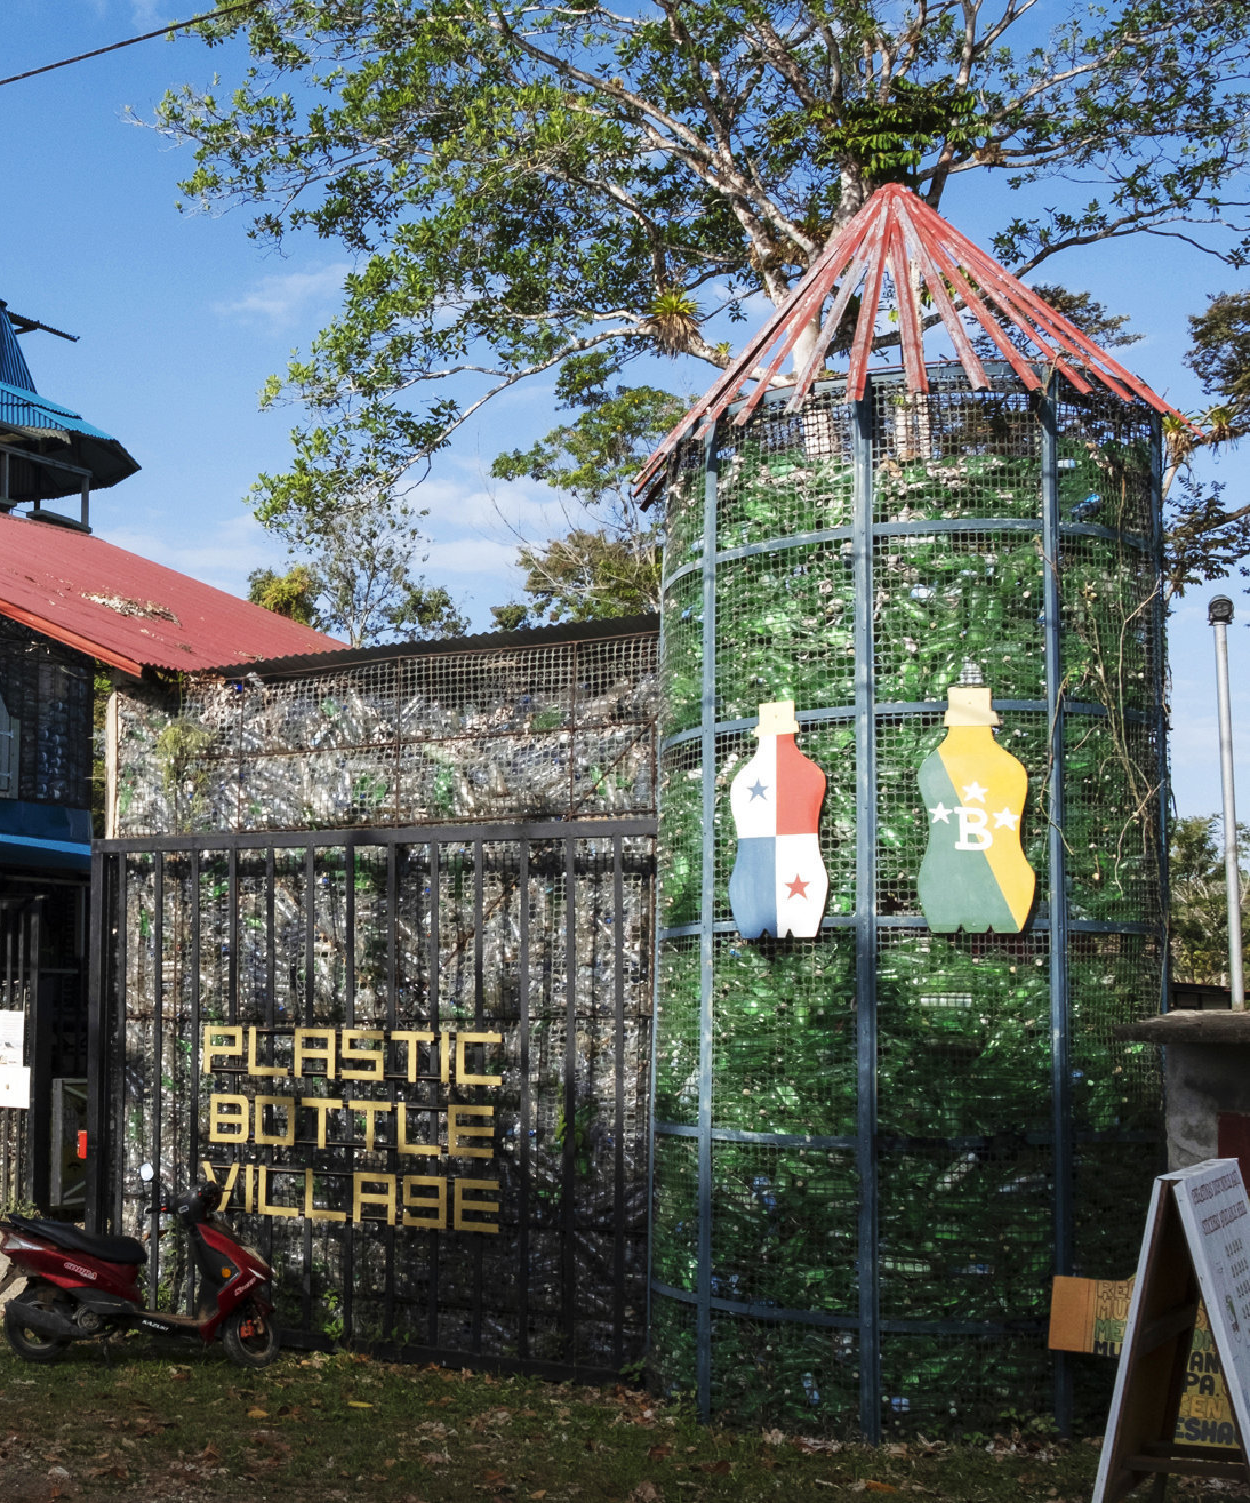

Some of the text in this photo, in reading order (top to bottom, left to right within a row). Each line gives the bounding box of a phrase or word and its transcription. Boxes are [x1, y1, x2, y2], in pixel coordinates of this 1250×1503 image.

[953, 806, 993, 850] B
[203, 1025, 503, 1086] PLASTIC
[209, 1093, 495, 1158] BOTTLE
